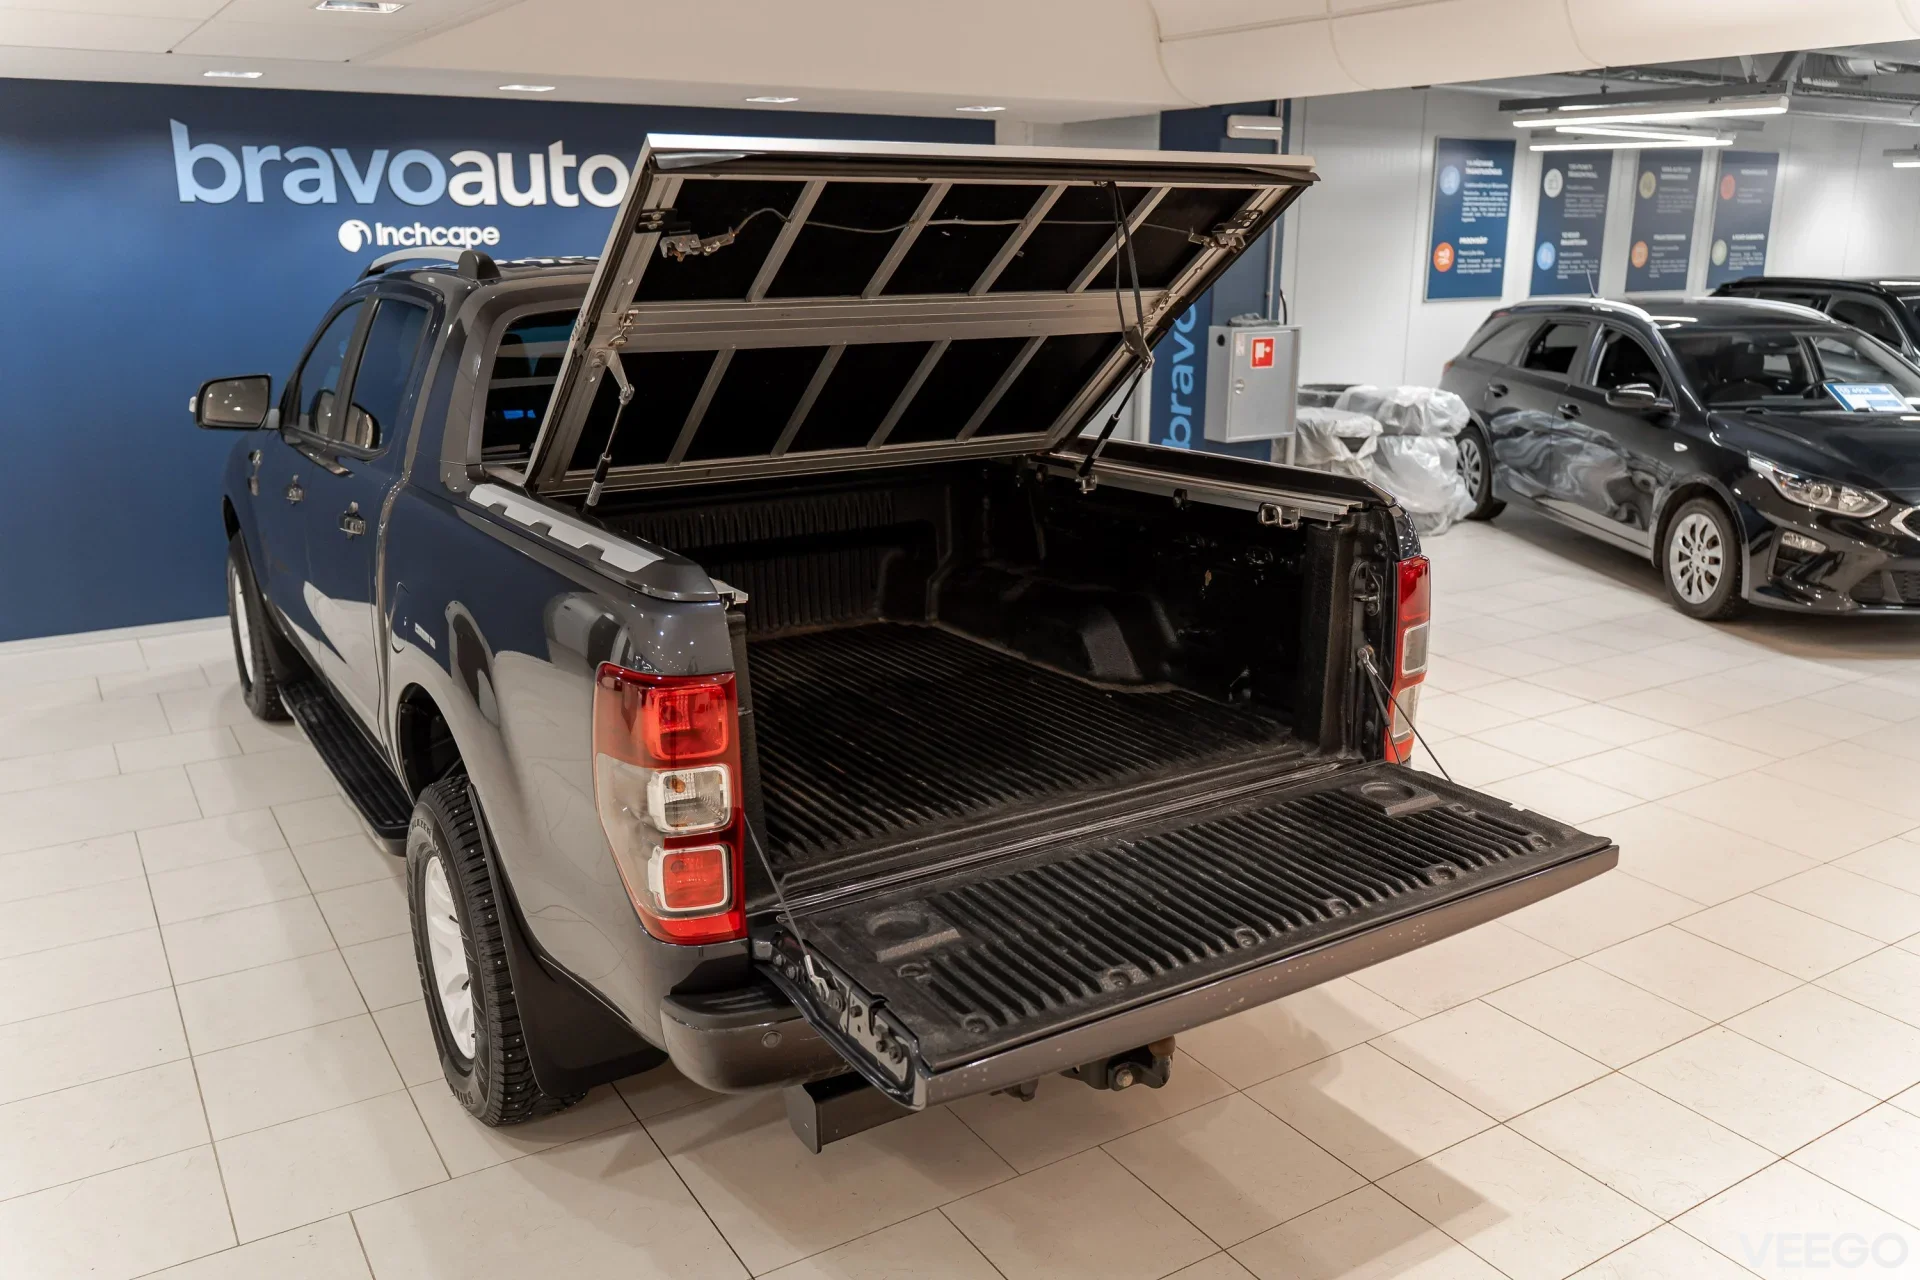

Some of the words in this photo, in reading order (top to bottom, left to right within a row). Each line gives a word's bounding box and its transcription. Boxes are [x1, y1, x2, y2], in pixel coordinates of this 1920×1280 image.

[169, 118, 631, 208] bravoauto
[375, 222, 501, 249] Inchcape
[1162, 304, 1197, 449] bravo
